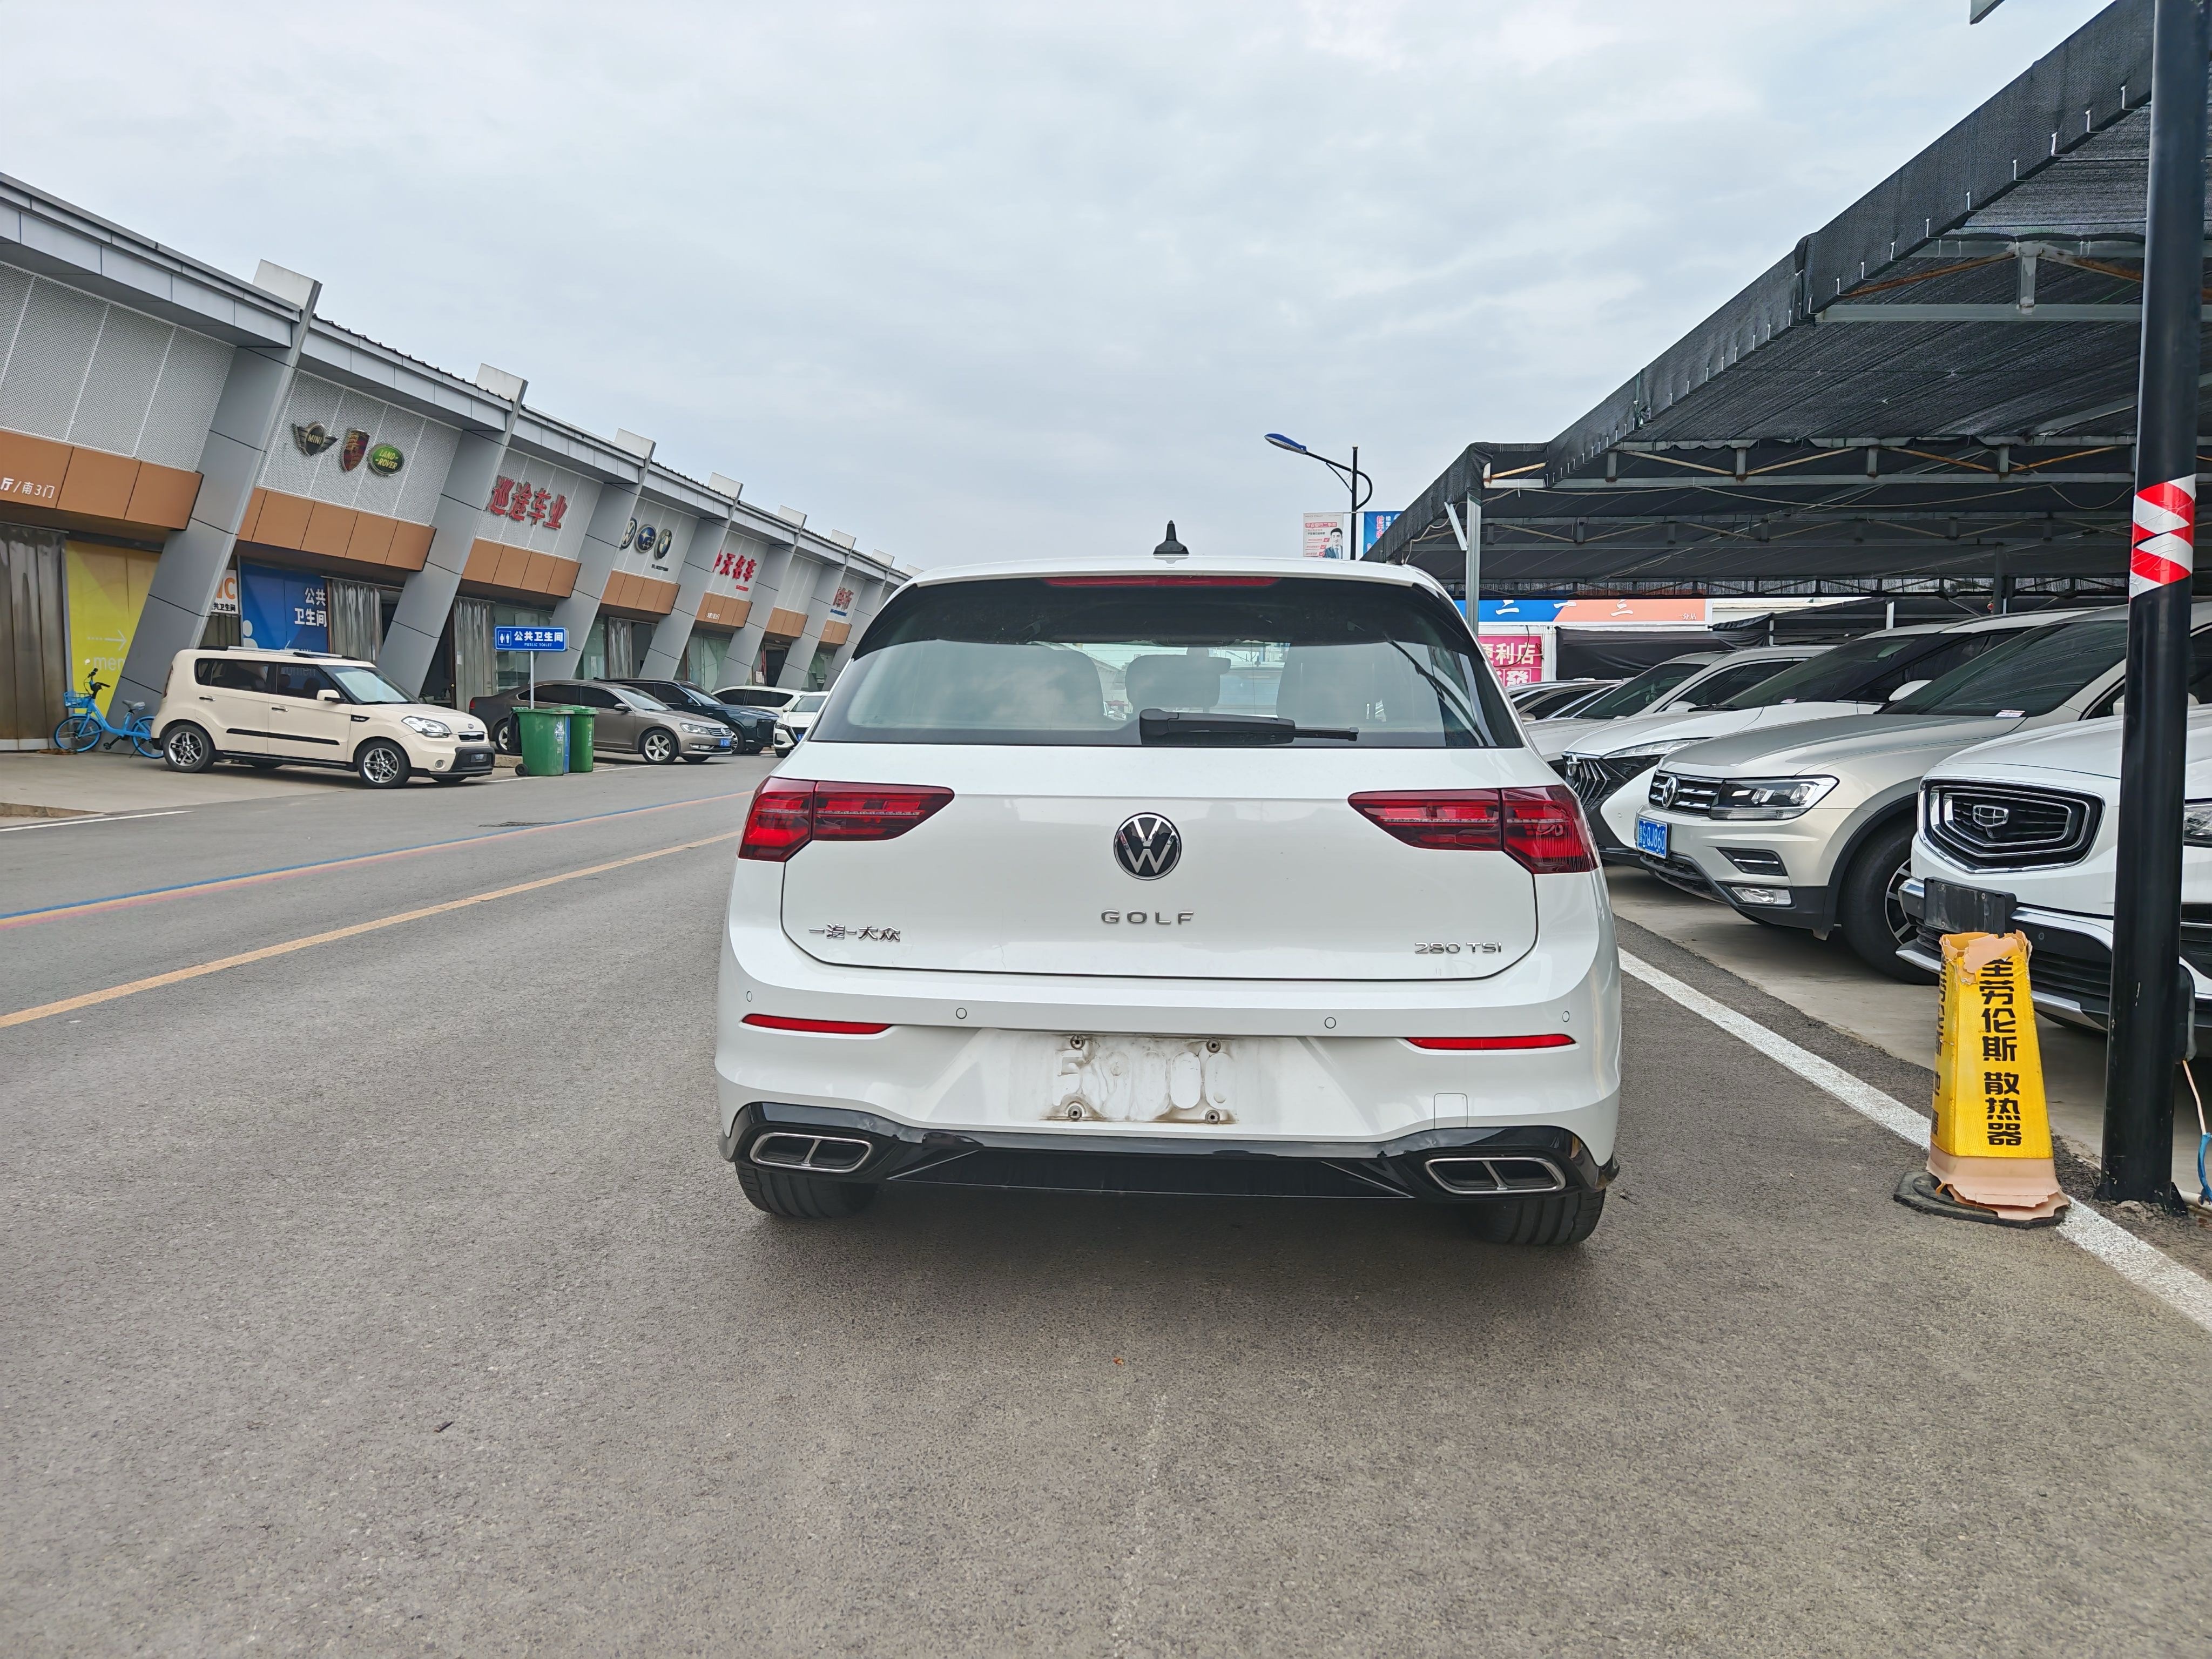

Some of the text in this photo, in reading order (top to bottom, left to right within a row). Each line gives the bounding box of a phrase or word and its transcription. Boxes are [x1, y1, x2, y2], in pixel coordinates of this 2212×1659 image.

[308, 434, 322, 444] MINI
[379, 449, 396, 460] LAND
[378, 458, 398, 470] ROVER
[305, 587, 326, 606] 公共
[211, 602, 236, 612] 共卫生间
[294, 607, 327, 627] 卫生间
[514, 631, 563, 642] 公共卫生间
[1101, 909, 1194, 925] GOLF
[1415, 942, 1502, 954] 280 TSI
[1984, 1071, 2022, 1146] 散热器
